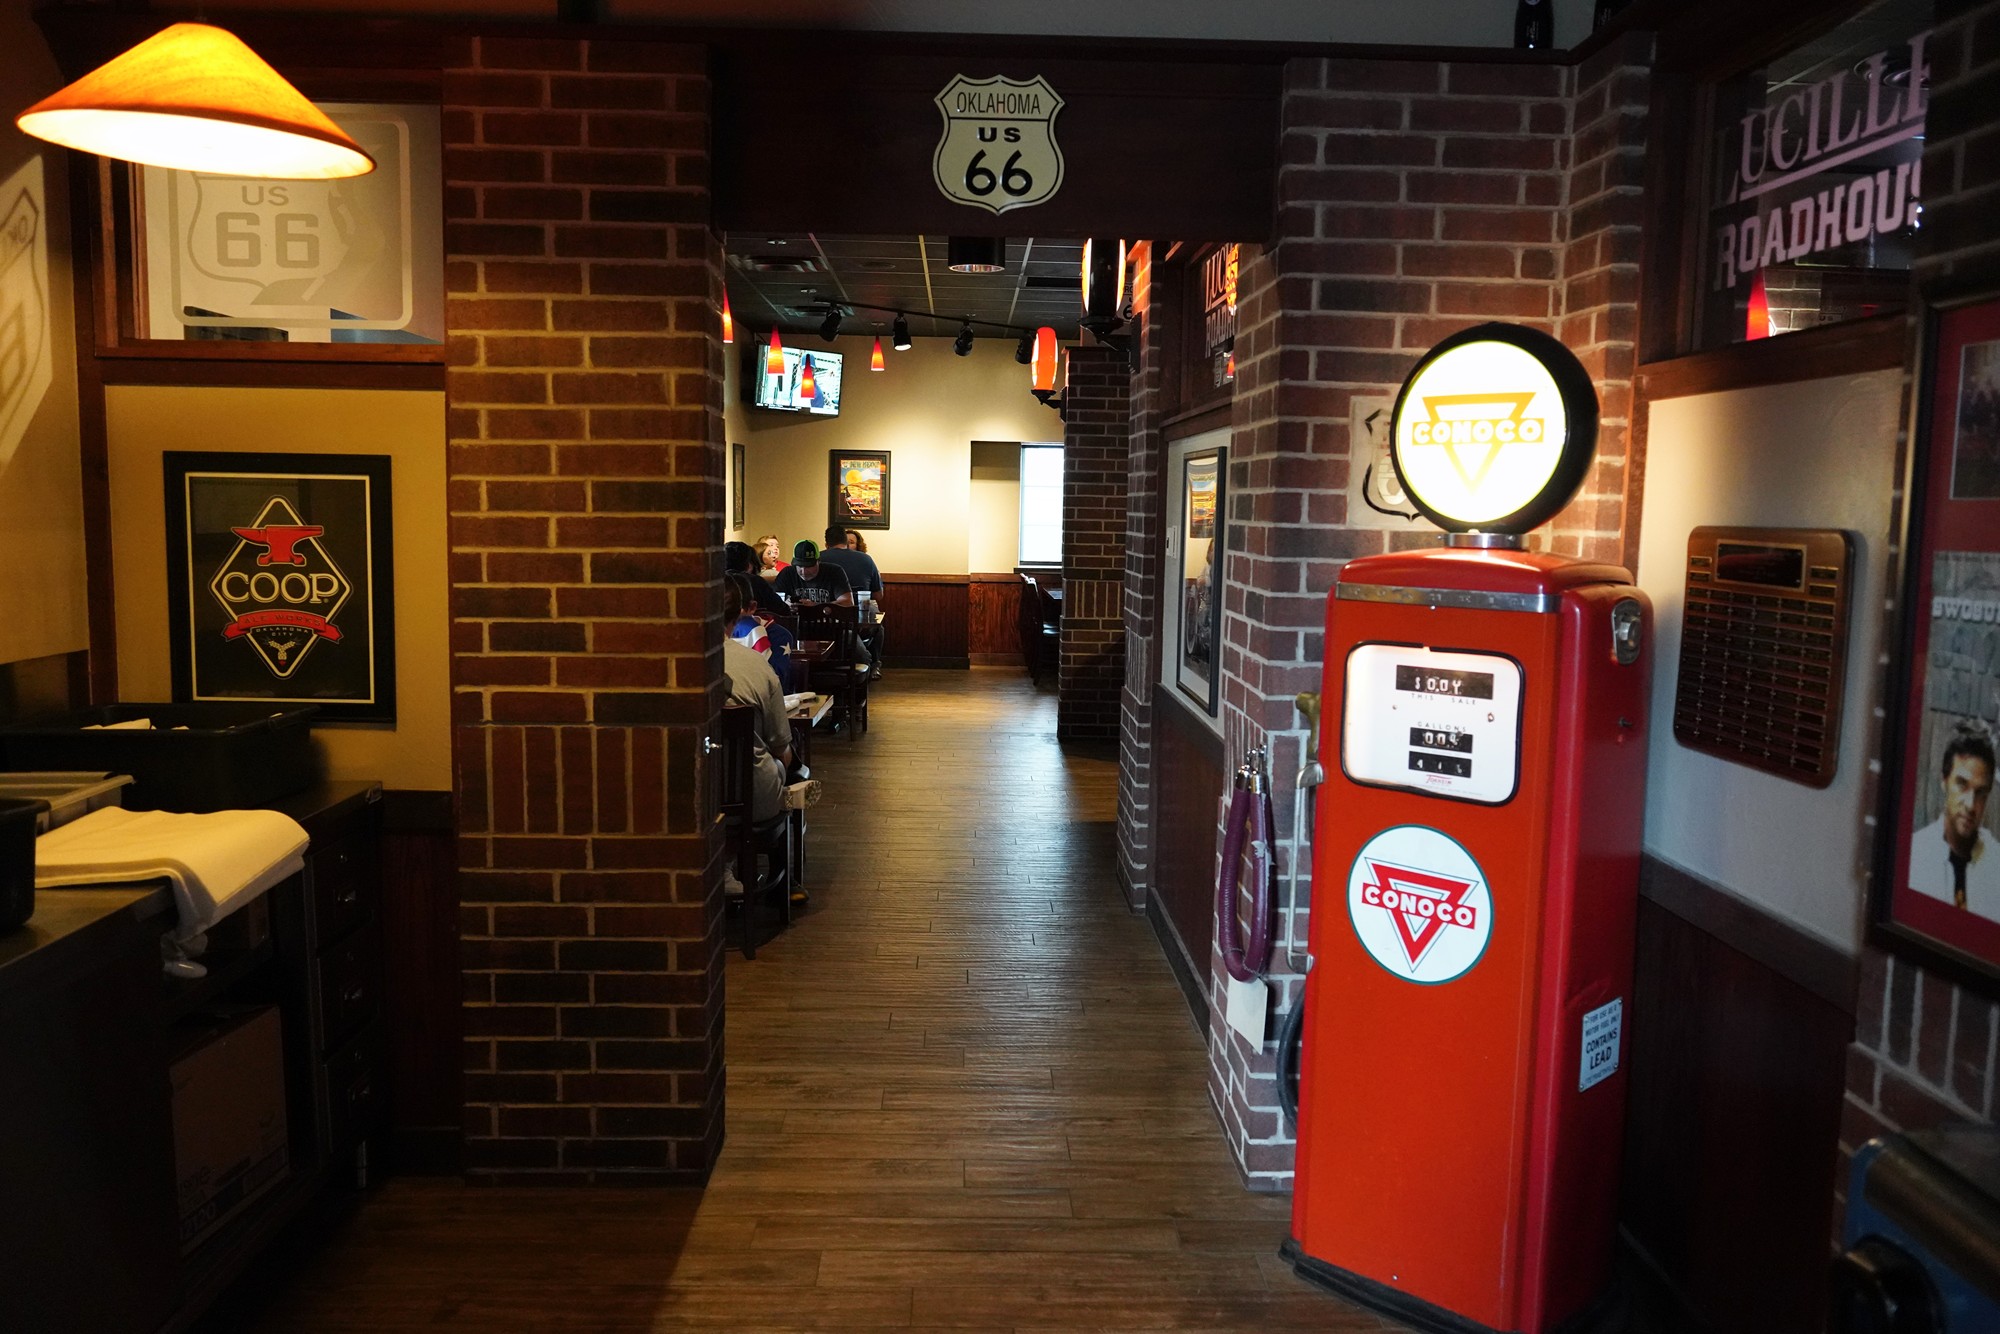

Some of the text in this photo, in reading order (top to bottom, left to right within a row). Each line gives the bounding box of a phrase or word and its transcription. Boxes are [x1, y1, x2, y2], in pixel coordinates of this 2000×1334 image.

[957, 92, 1040, 114] OKLAHOMA
[977, 126, 1022, 143] US
[964, 149, 1033, 197] 66
[241, 185, 290, 206] US
[215, 211, 320, 268] 66
[1412, 418, 1544, 445] CONOCO
[221, 571, 340, 605] COOP
[244, 613, 322, 628] ALE WORKS
[256, 626, 310, 635] OKLAHOMA
[1411, 693, 1477, 706] THIS SALE
[1417, 721, 1467, 732] GALLONS
[1364, 886, 1474, 927] CONOCO
[1586, 1028, 1617, 1054] CONTAINS
[1590, 1047, 1612, 1070] LEAD
